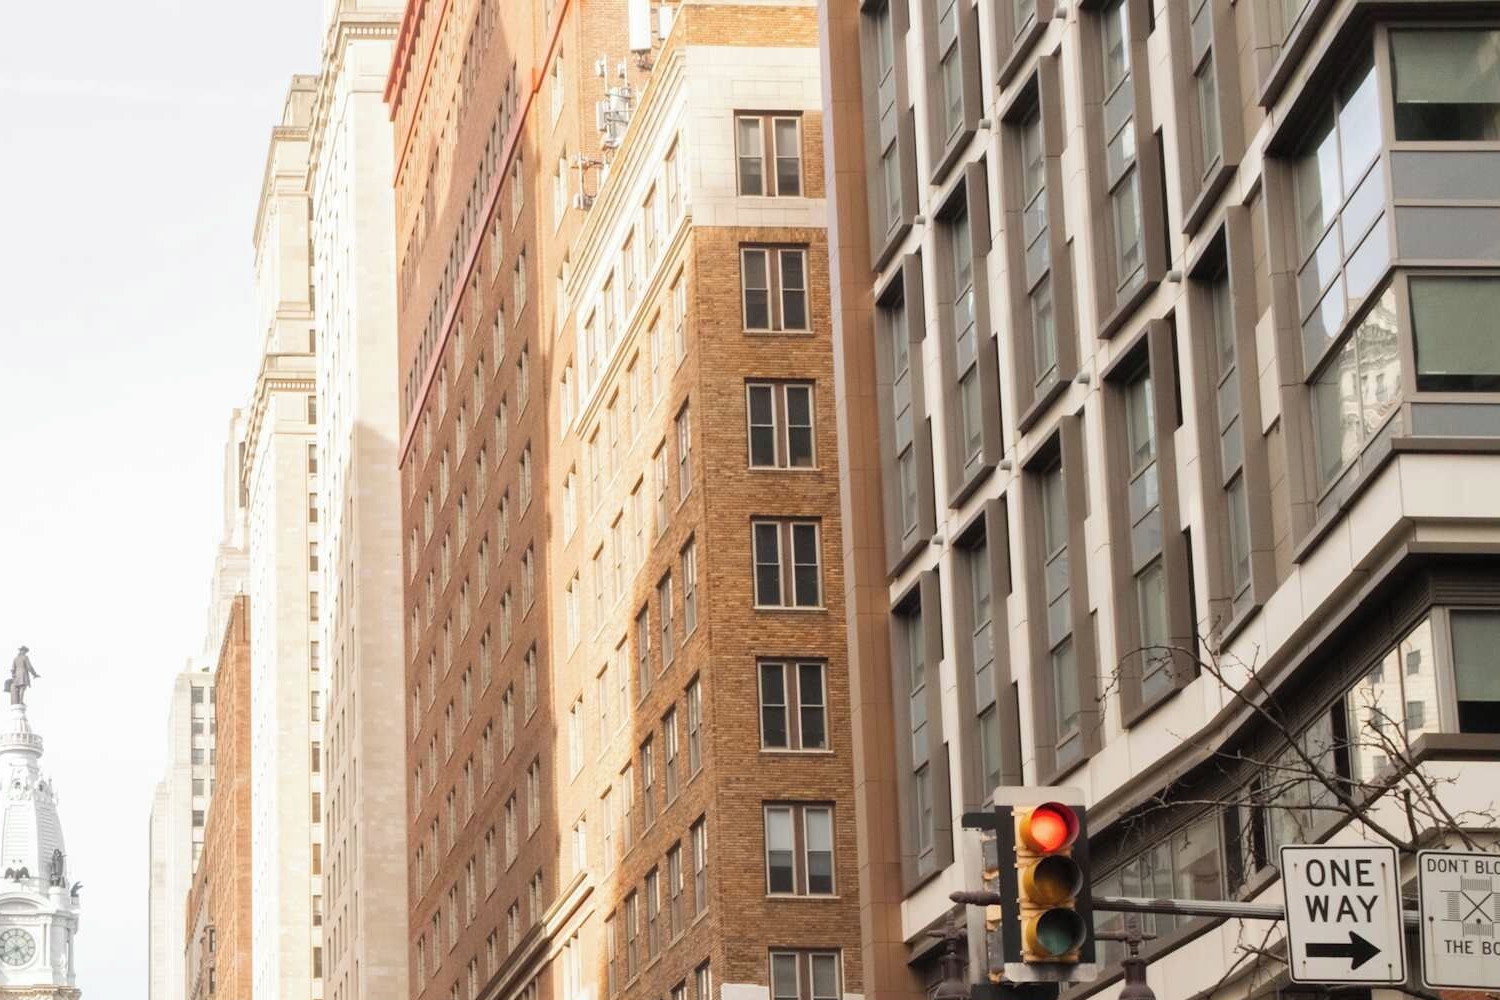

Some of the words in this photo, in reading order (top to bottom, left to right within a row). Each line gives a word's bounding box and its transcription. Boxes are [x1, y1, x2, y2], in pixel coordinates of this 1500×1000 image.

[1306, 859, 1374, 887] ONE
[1427, 859, 1468, 873] DON'T
[1305, 895, 1378, 923] WAY
[1444, 940, 1474, 955] THE
